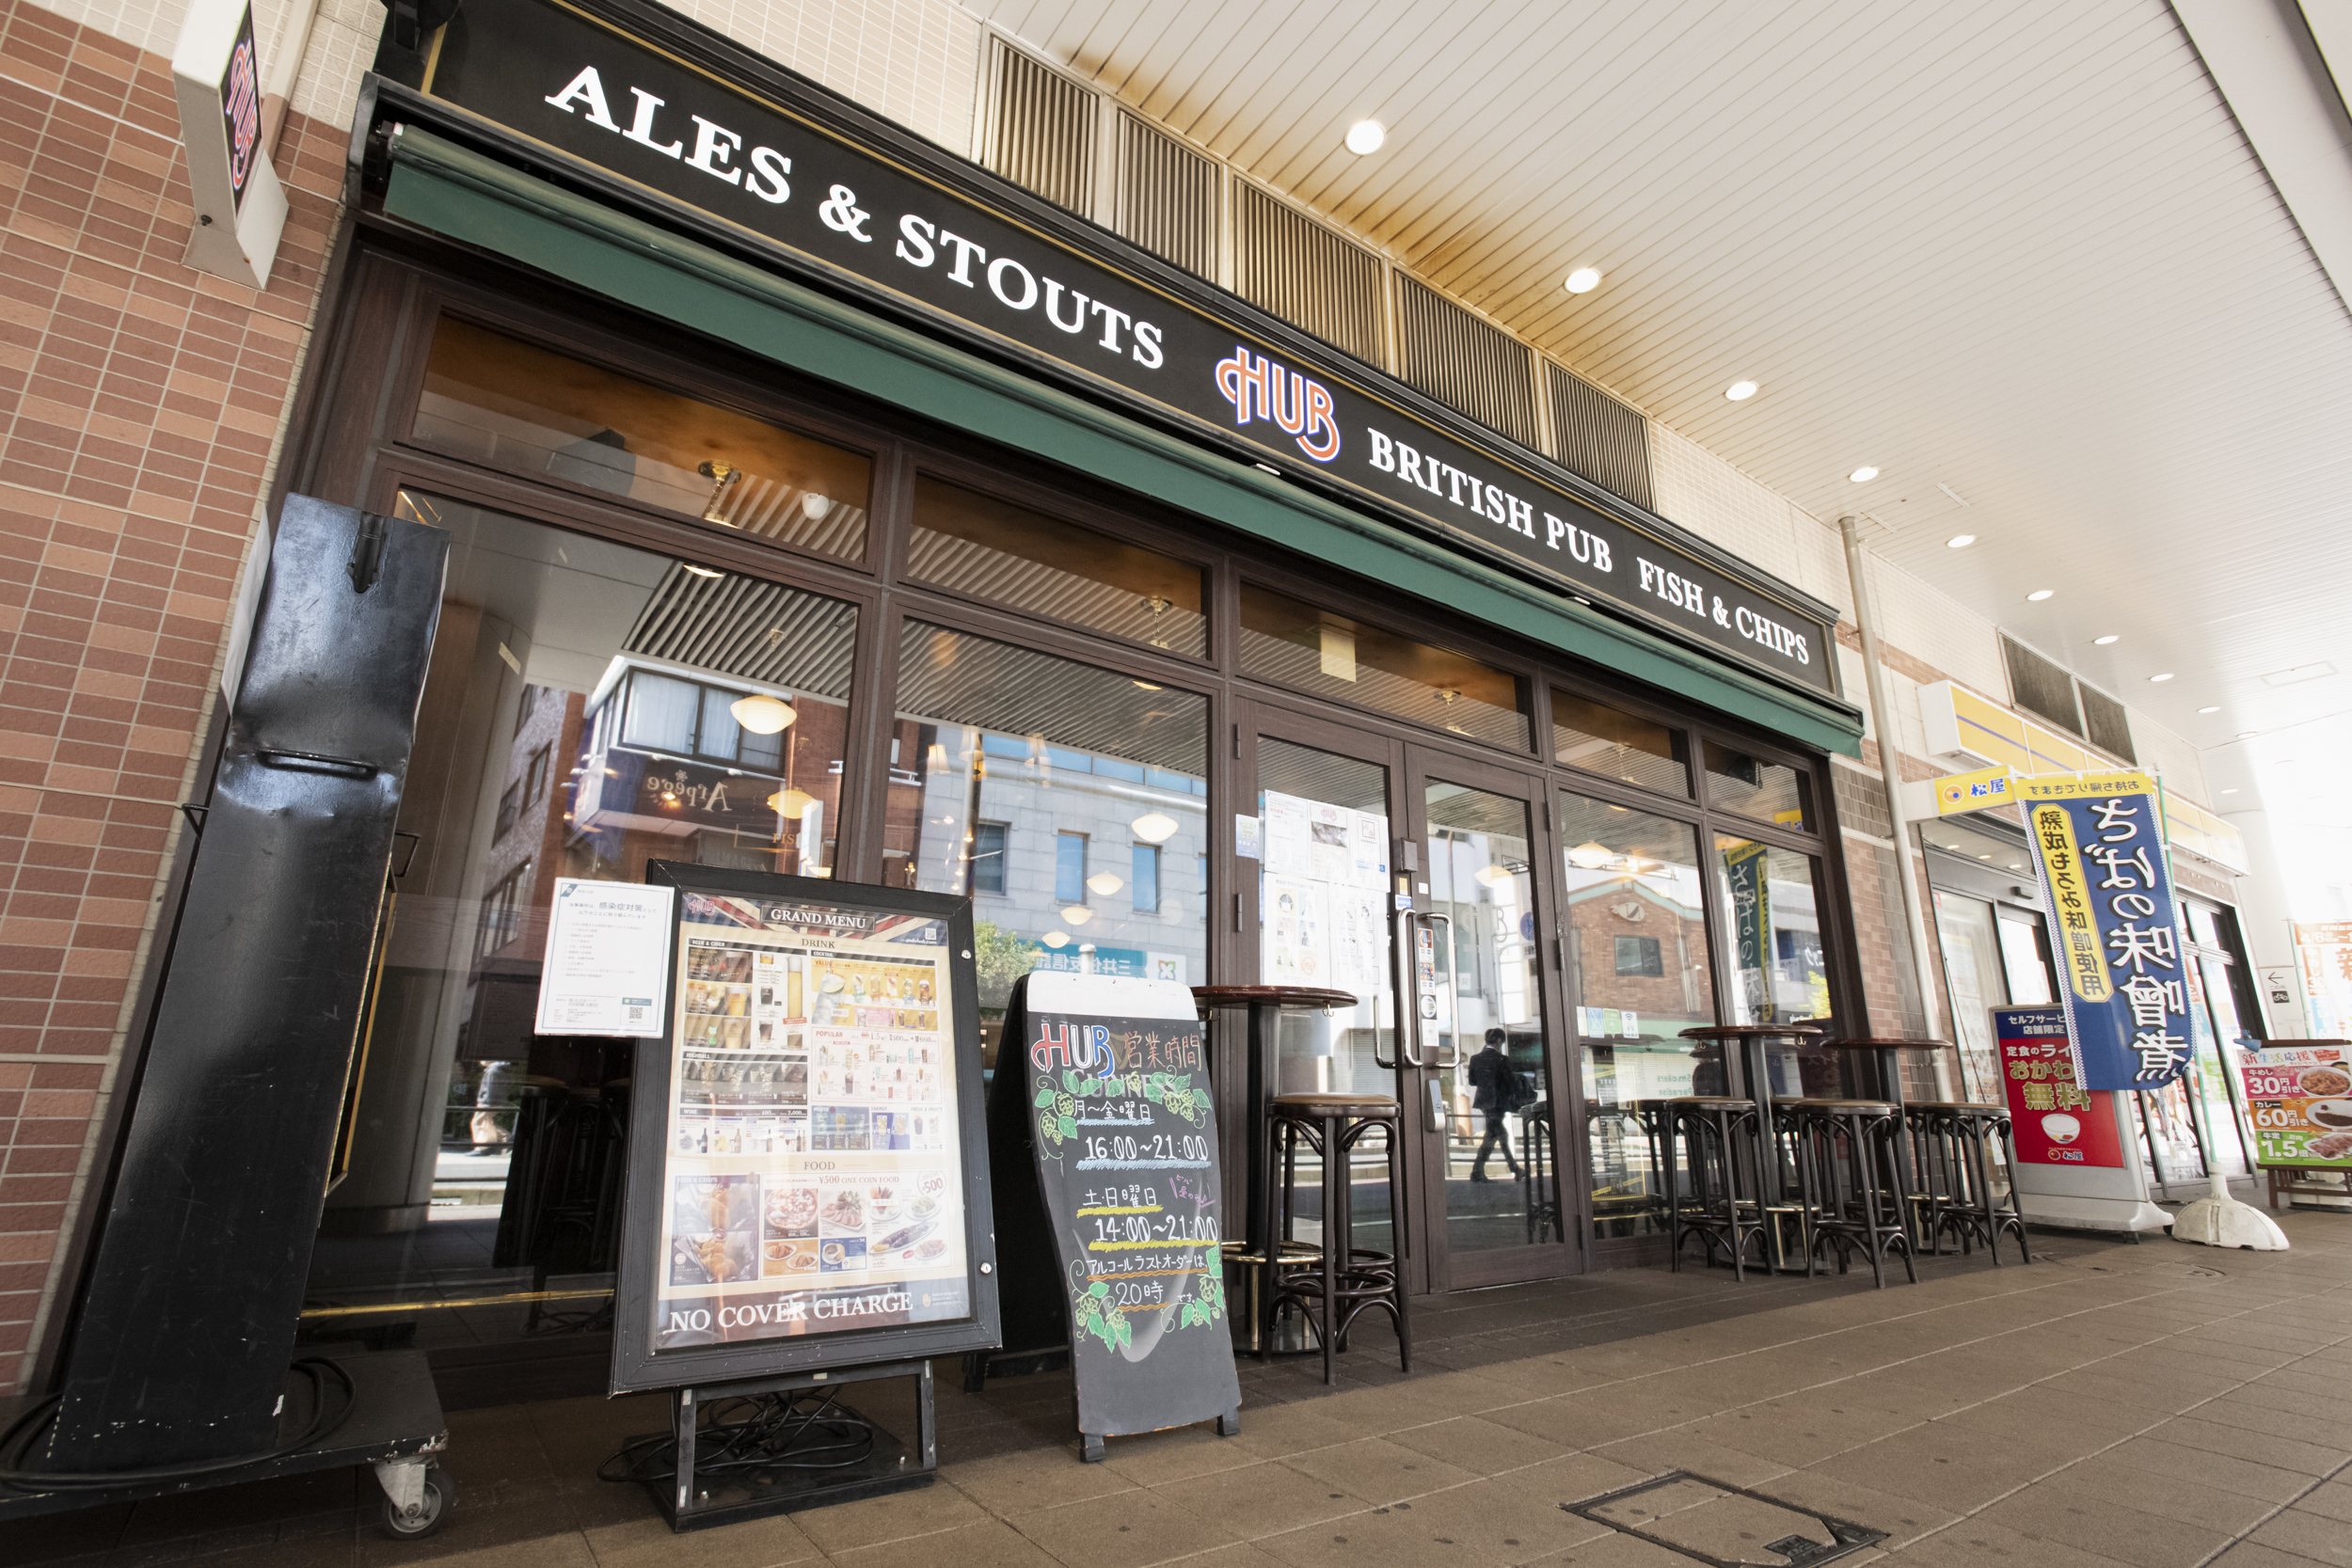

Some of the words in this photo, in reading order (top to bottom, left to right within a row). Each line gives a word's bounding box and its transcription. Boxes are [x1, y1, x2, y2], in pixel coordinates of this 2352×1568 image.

[225, 38, 257, 190] HUB
[545, 66, 792, 204] ALES
[818, 184, 872, 243] &
[896, 214, 1164, 370] STOUTS
[1215, 345, 1341, 462] HUB
[1368, 427, 1535, 539] BRITISH
[1544, 512, 1613, 573] PUB
[1637, 556, 1705, 618] FISH
[1711, 594, 1731, 628] &
[1735, 606, 1809, 665] CHIPS
[1970, 778, 2007, 797] 松屋
[1320, 807, 1337, 823] HUB
[688, 899, 716, 916] HUB
[771, 909, 821, 924] GRAND
[825, 915, 866, 929] MENU
[802, 939, 835, 948] DRINK
[2023, 1024, 2066, 1035] 店舗限定
[1031, 1022, 1115, 1078] HUB
[1124, 1031, 1201, 1071] 営業時間
[2241, 1050, 2312, 1066] 新生活応援
[2022, 1082, 2091, 1111] 無料
[803, 1162, 835, 1170] FOOD
[2061, 1151, 2084, 1161] 松屋
[818, 1176, 839, 1184] ¥500
[1116, 1280, 1164, 1306] 20時
[670, 1308, 711, 1332] NO
[718, 1301, 808, 1328] COVER
[813, 1292, 914, 1319] CHARGE
